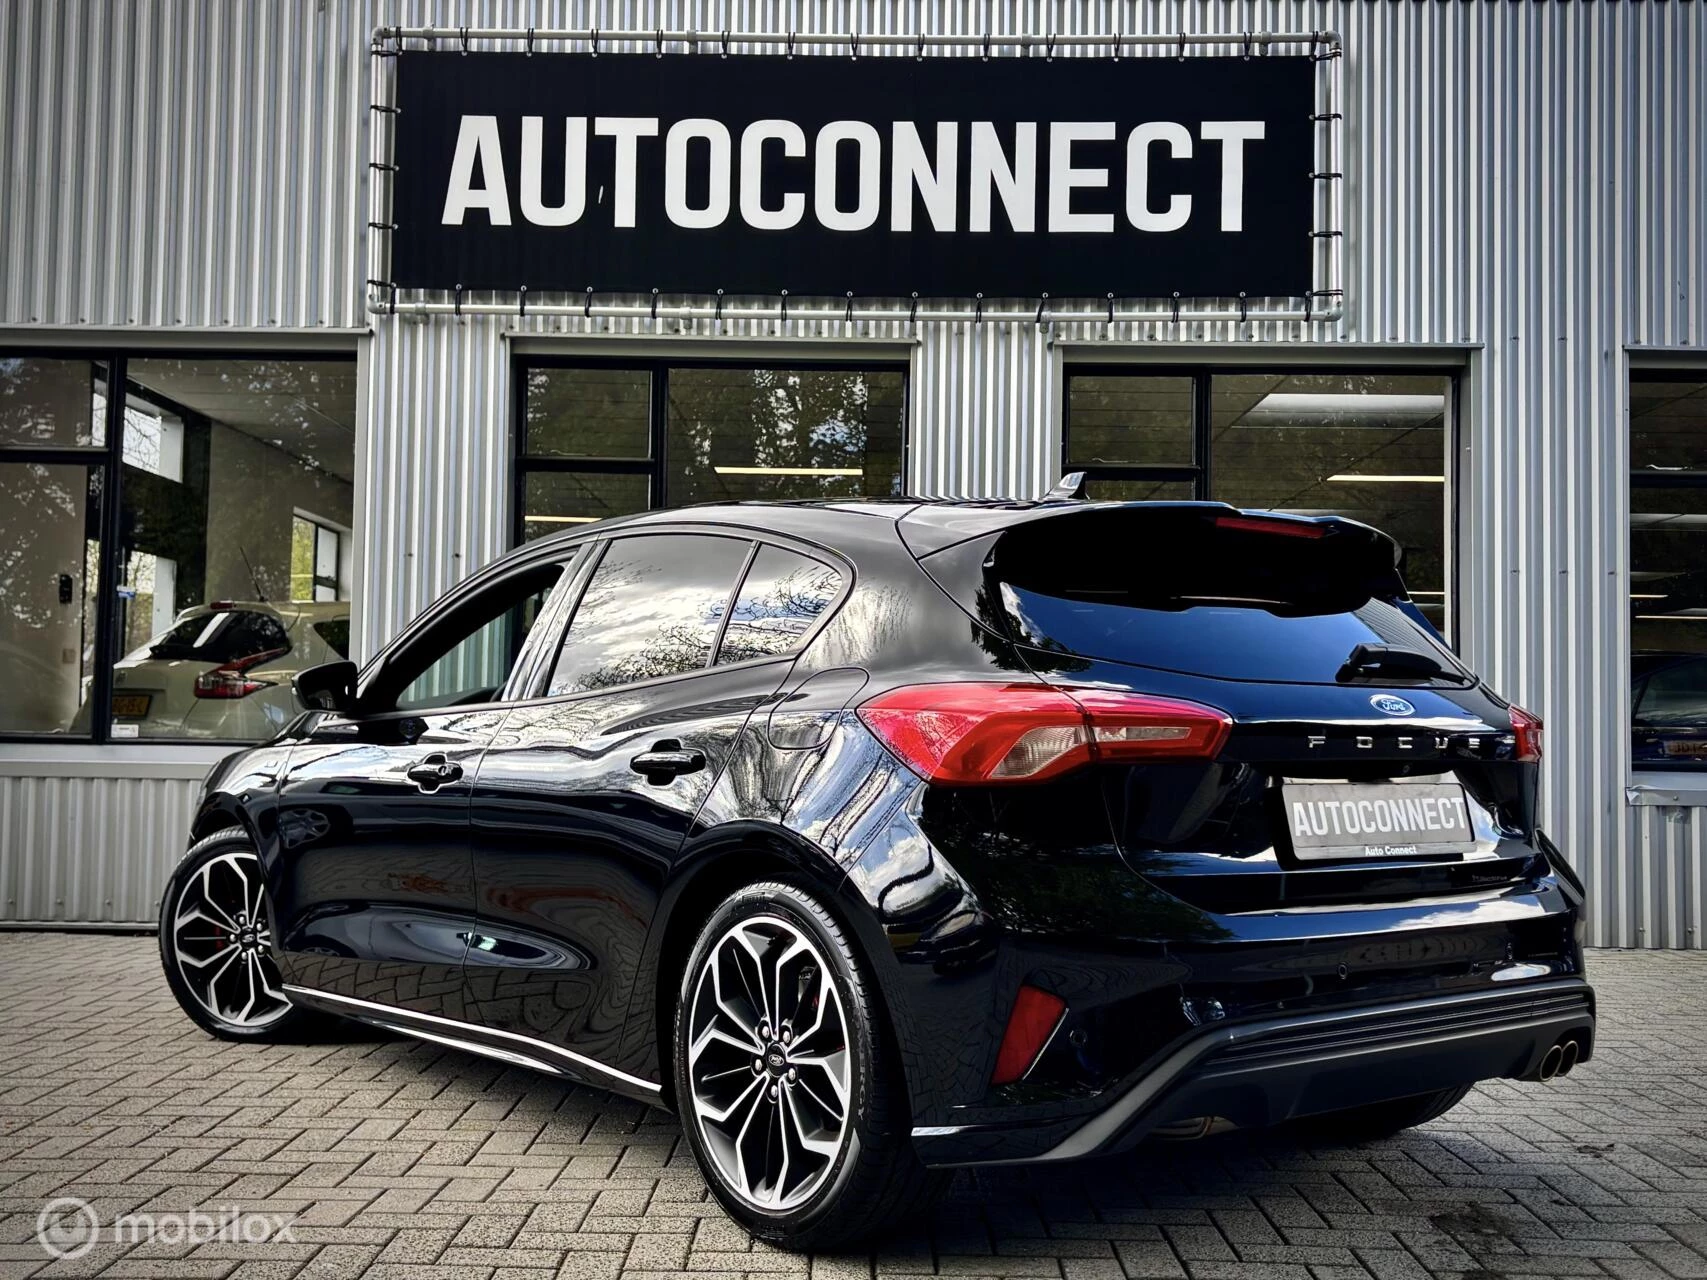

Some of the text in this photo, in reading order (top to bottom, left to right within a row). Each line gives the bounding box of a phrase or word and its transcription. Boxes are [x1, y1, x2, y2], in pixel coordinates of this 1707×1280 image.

[441, 114, 1265, 234] AUTOCONNECT
[1292, 798, 1467, 837] AUTOCONNECT
[1365, 845, 1417, 856] Auto Connect
